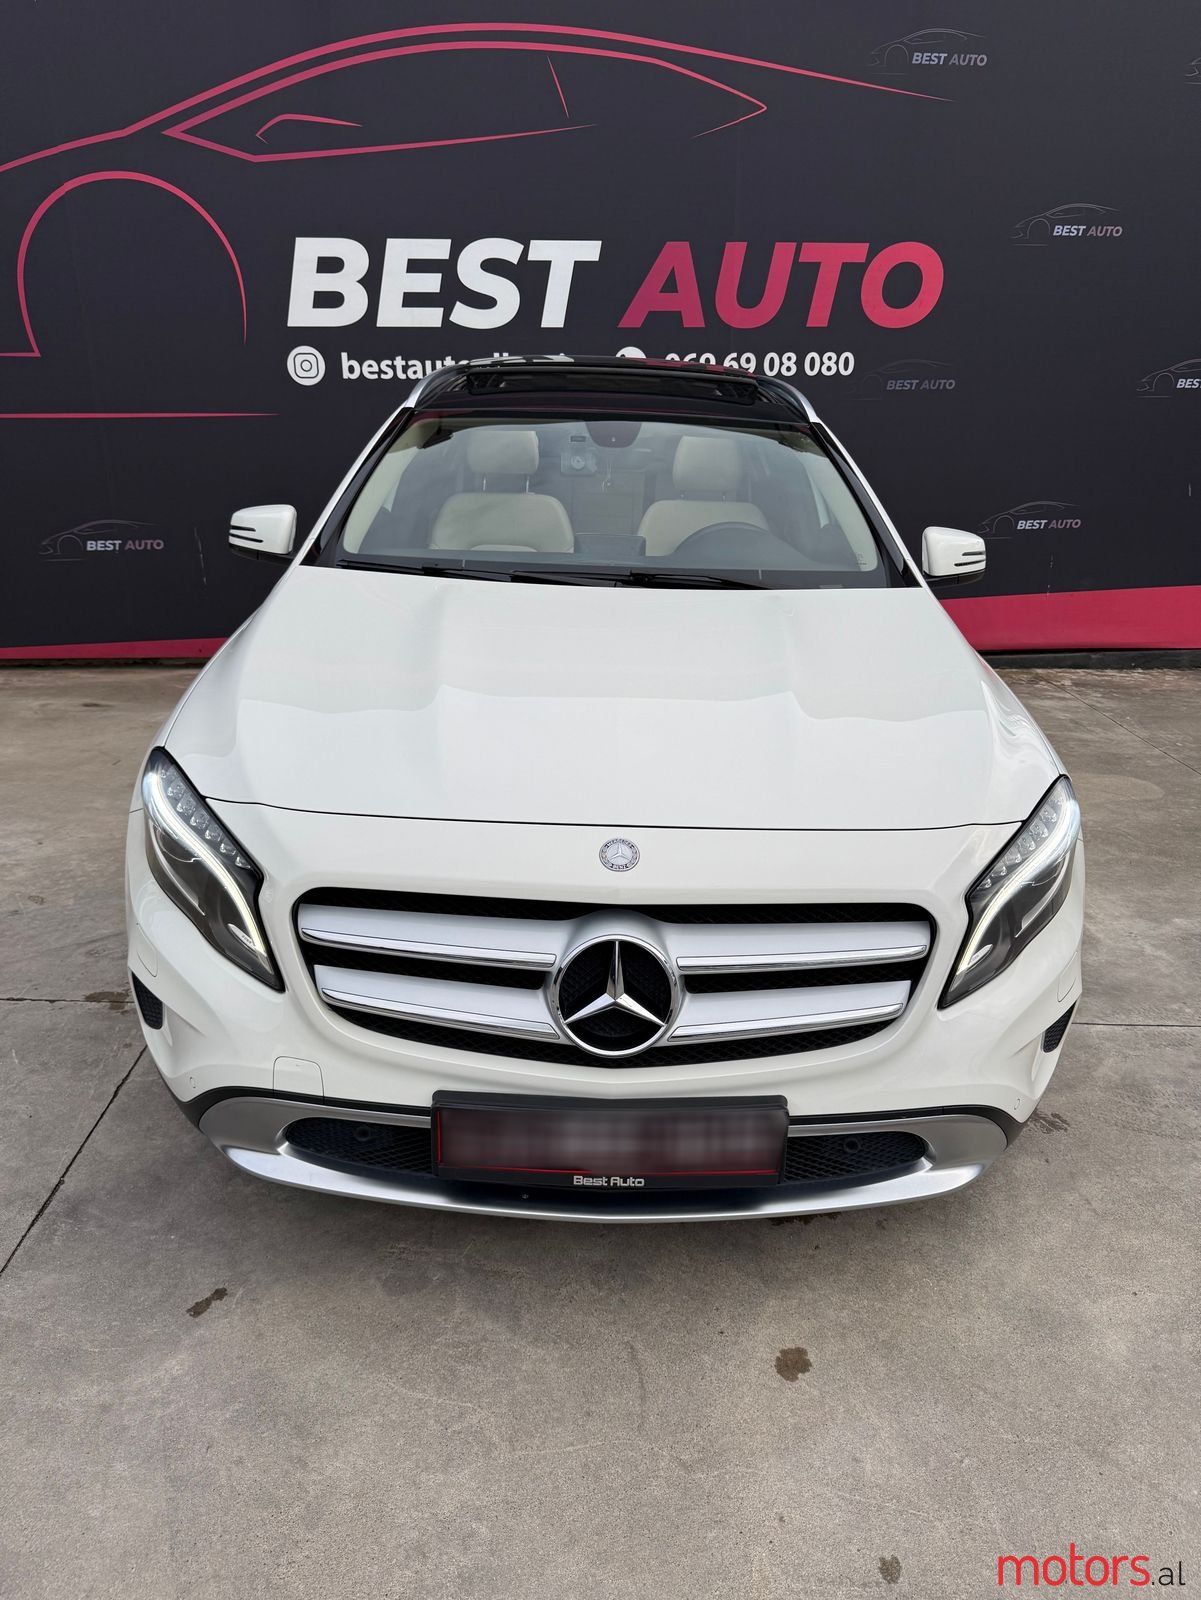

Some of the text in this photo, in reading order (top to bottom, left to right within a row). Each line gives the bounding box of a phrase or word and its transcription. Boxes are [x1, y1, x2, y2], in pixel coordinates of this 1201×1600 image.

[912, 52, 987, 66] BEST AUTO
[1053, 225, 1123, 237] BEST AUTO
[287, 237, 944, 329] BEST AUTO
[763, 352, 797, 376] 08
[804, 352, 855, 376] 080
[886, 379, 956, 390] BEST AUTO
[1176, 378, 1201, 389] BES
[1017, 519, 1081, 530] BEST AUTO
[86, 539, 164, 551] BEST AUTO
[573, 1175, 645, 1187] Best Auto
